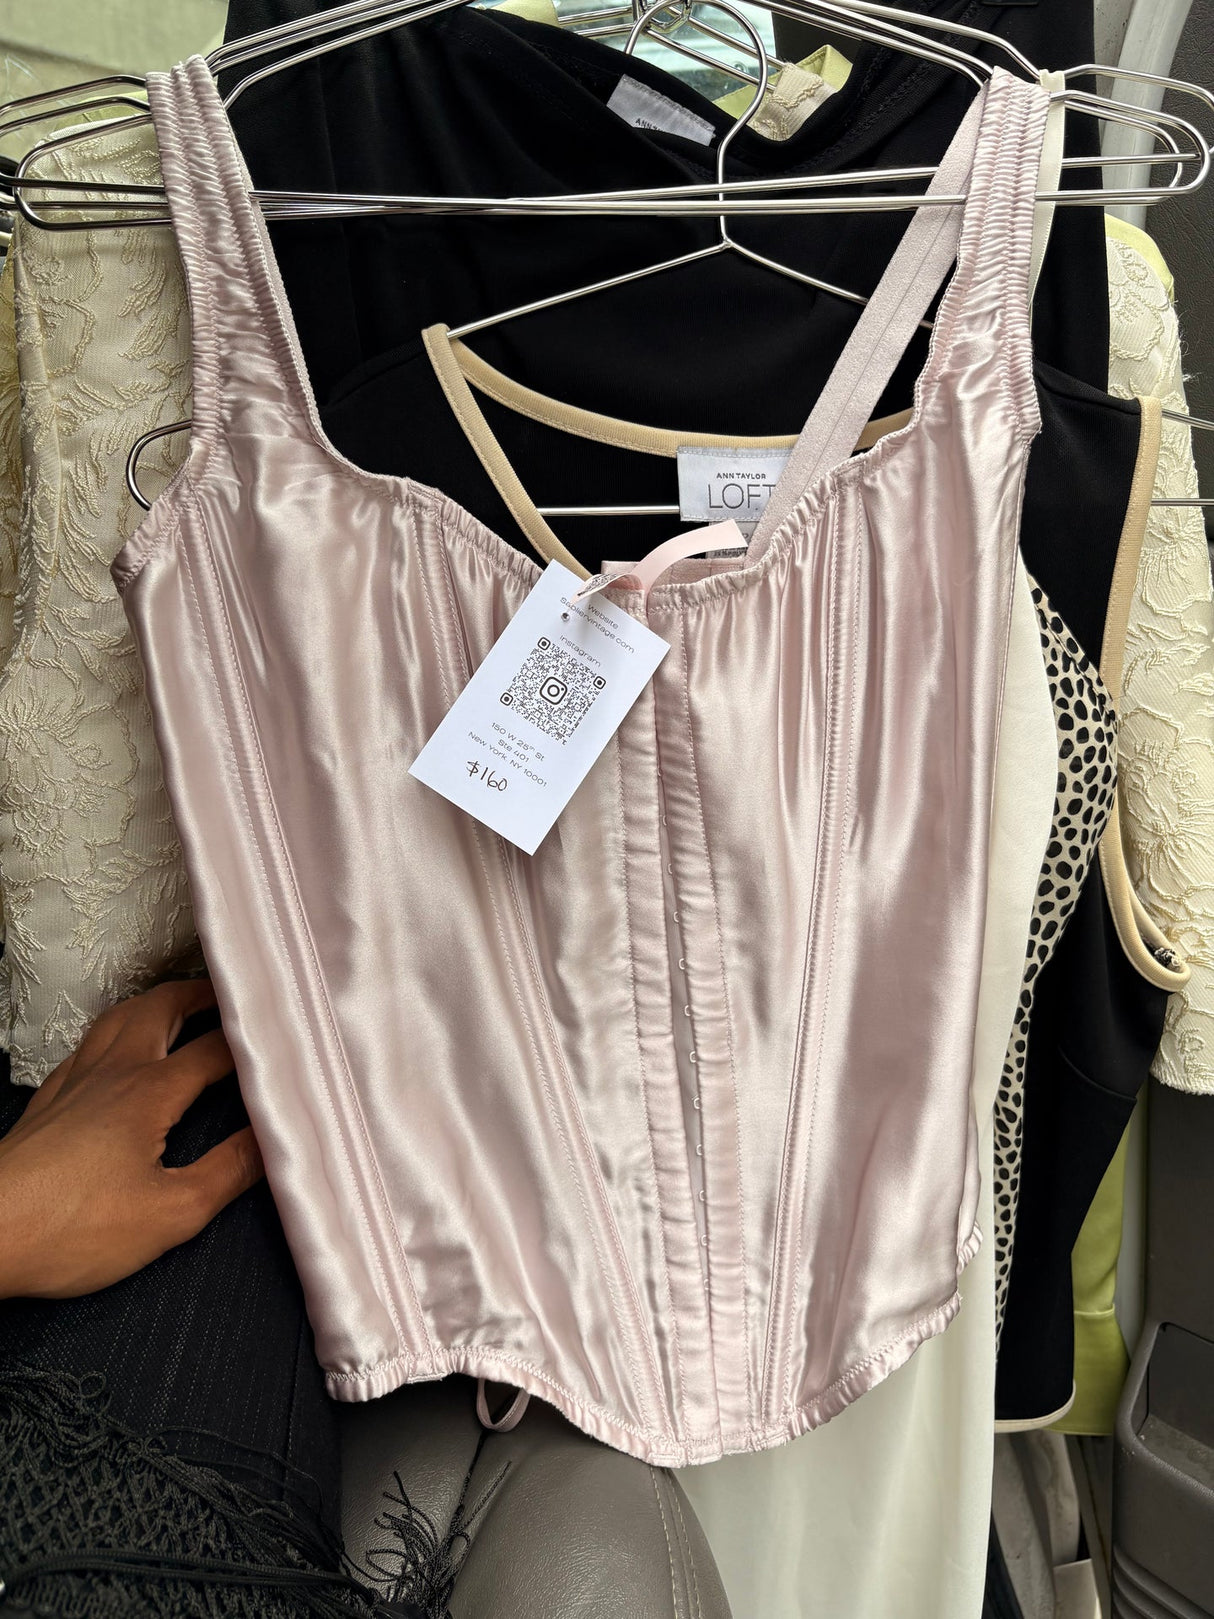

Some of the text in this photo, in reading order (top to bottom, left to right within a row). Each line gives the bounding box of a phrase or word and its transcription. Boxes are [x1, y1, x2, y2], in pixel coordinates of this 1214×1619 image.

[716, 472, 767, 480] ANN TAYLOR
[708, 483, 777, 509] LOFT
[587, 604, 619, 630] Website
[560, 635, 601, 667] Instagram
[491, 722, 507, 735] 150
[507, 732, 517, 741] W
[534, 751, 545, 762] St
[497, 739, 530, 763] Ste 401
[467, 731, 487, 747] New
[509, 759, 522, 769] NY
[523, 768, 548, 787] 10001
[466, 760, 508, 792] $160
